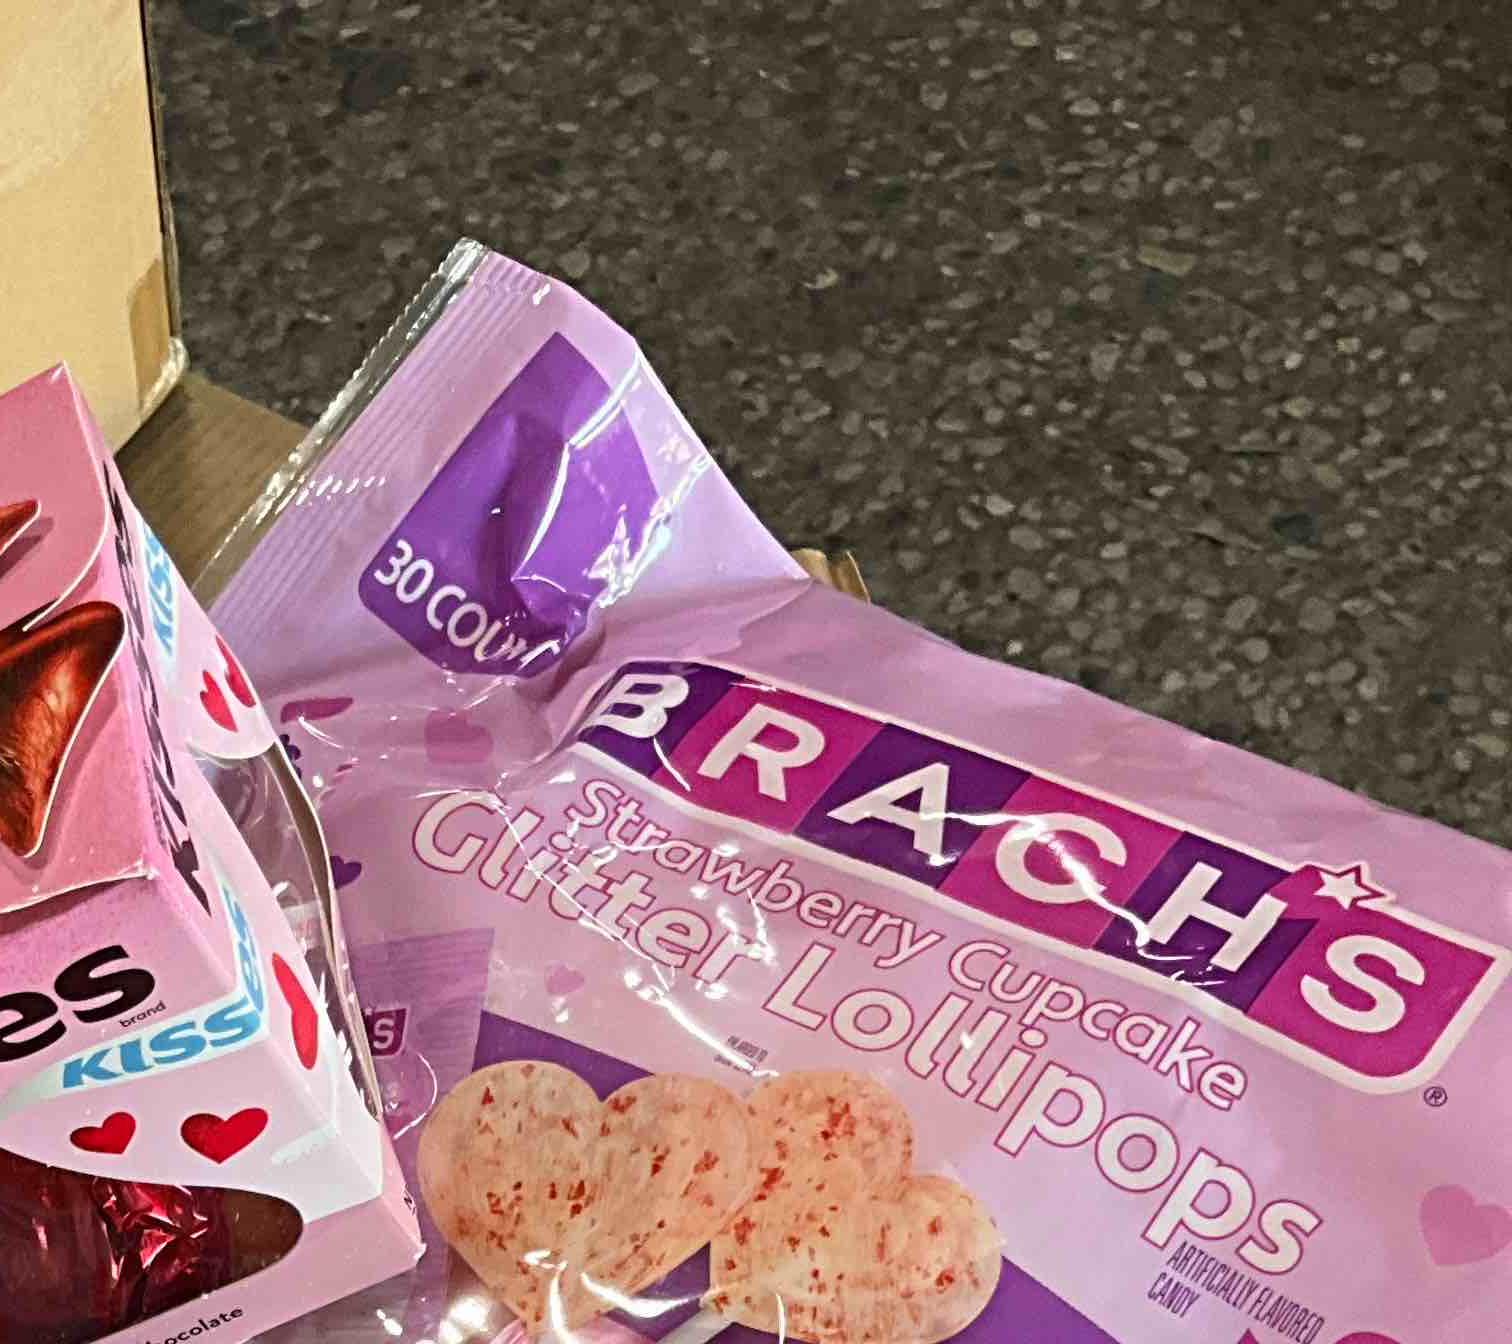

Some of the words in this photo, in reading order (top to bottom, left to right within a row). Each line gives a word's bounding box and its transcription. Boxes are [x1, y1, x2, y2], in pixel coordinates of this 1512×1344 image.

[374, 537, 432, 604] 30
[564, 777, 949, 968] Strawberry
[948, 936, 1252, 1115] Cupcake
[60, 1002, 263, 1090] KISS
[119, 1000, 167, 1030] brand
[411, 791, 772, 986] Glitter
[765, 943, 1324, 1277] Lollipops
[1147, 1271, 1201, 1319] CANDY
[1165, 1240, 1260, 1311] ARTIFICIALLY
